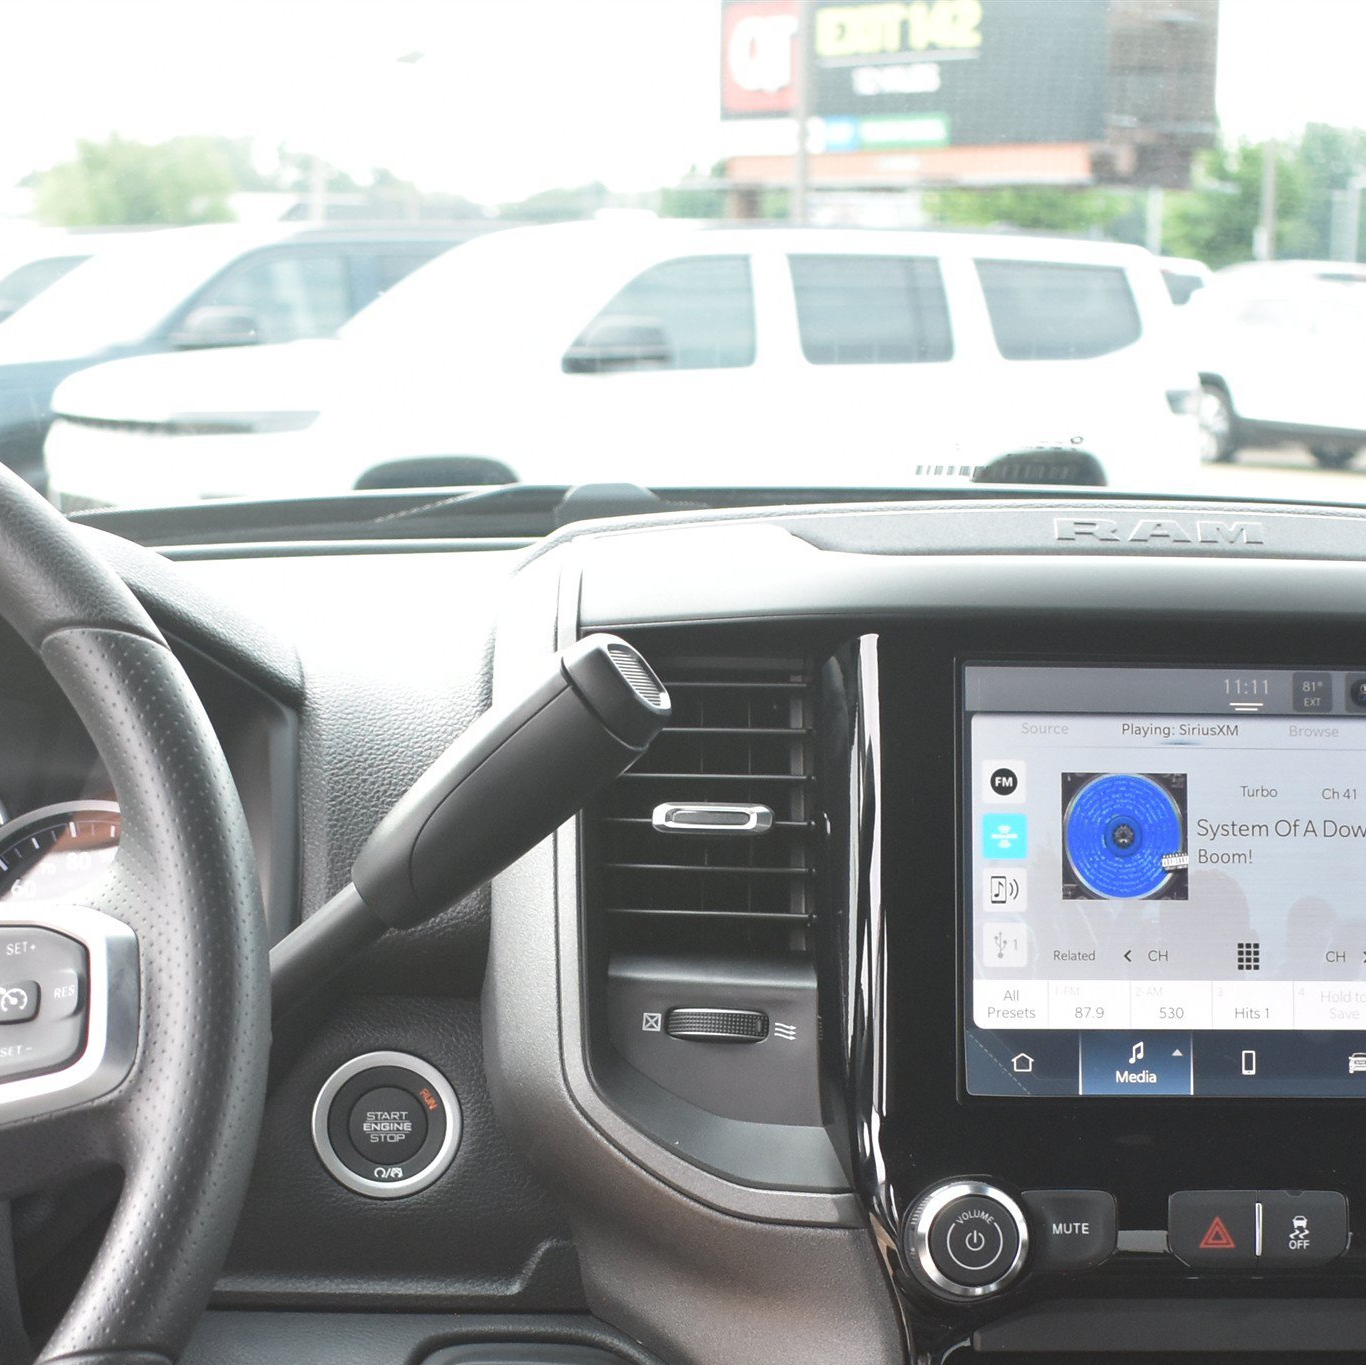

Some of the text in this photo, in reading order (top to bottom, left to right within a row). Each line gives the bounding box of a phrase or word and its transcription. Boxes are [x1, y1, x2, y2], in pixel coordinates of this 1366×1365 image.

[1053, 517, 1265, 545] RAM
[1223, 678, 1270, 695] 11:11
[1303, 697, 1321, 708] EXT
[1020, 721, 1069, 736] Source
[1121, 723, 1240, 739] Playing: SiriusXM
[1288, 725, 1339, 738] Browse
[993, 776, 1014, 788] FM
[1240, 785, 1279, 799] Turbo
[1321, 787, 1358, 801] Ch 41
[1196, 818, 1270, 841] System
[1274, 818, 1300, 838] Of
[1302, 820, 1318, 838] A
[1197, 848, 1253, 865] Boom!
[1052, 949, 1096, 962] Related
[1147, 950, 1169, 963] CH
[1325, 951, 1346, 963] CH
[53, 985, 75, 999] RES
[1003, 989, 1020, 1002] All
[1320, 991, 1351, 1004] Hold
[987, 1007, 1036, 1019] Presets
[1074, 1007, 1105, 1019] 87.9
[1159, 1007, 1185, 1019] 530
[1235, 1007, 1270, 1020] Hits 1
[1329, 1008, 1361, 1020] Save
[1115, 1069, 1158, 1084] Media
[419, 1087, 438, 1111] RUN
[366, 1111, 409, 1121] START
[362, 1122, 412, 1132] ENGINE
[370, 1134, 406, 1143] STOP
[954, 1209, 995, 1225] VOLUME
[1051, 1222, 1090, 1236] MUTE
[1288, 1239, 1311, 1250] OFF
